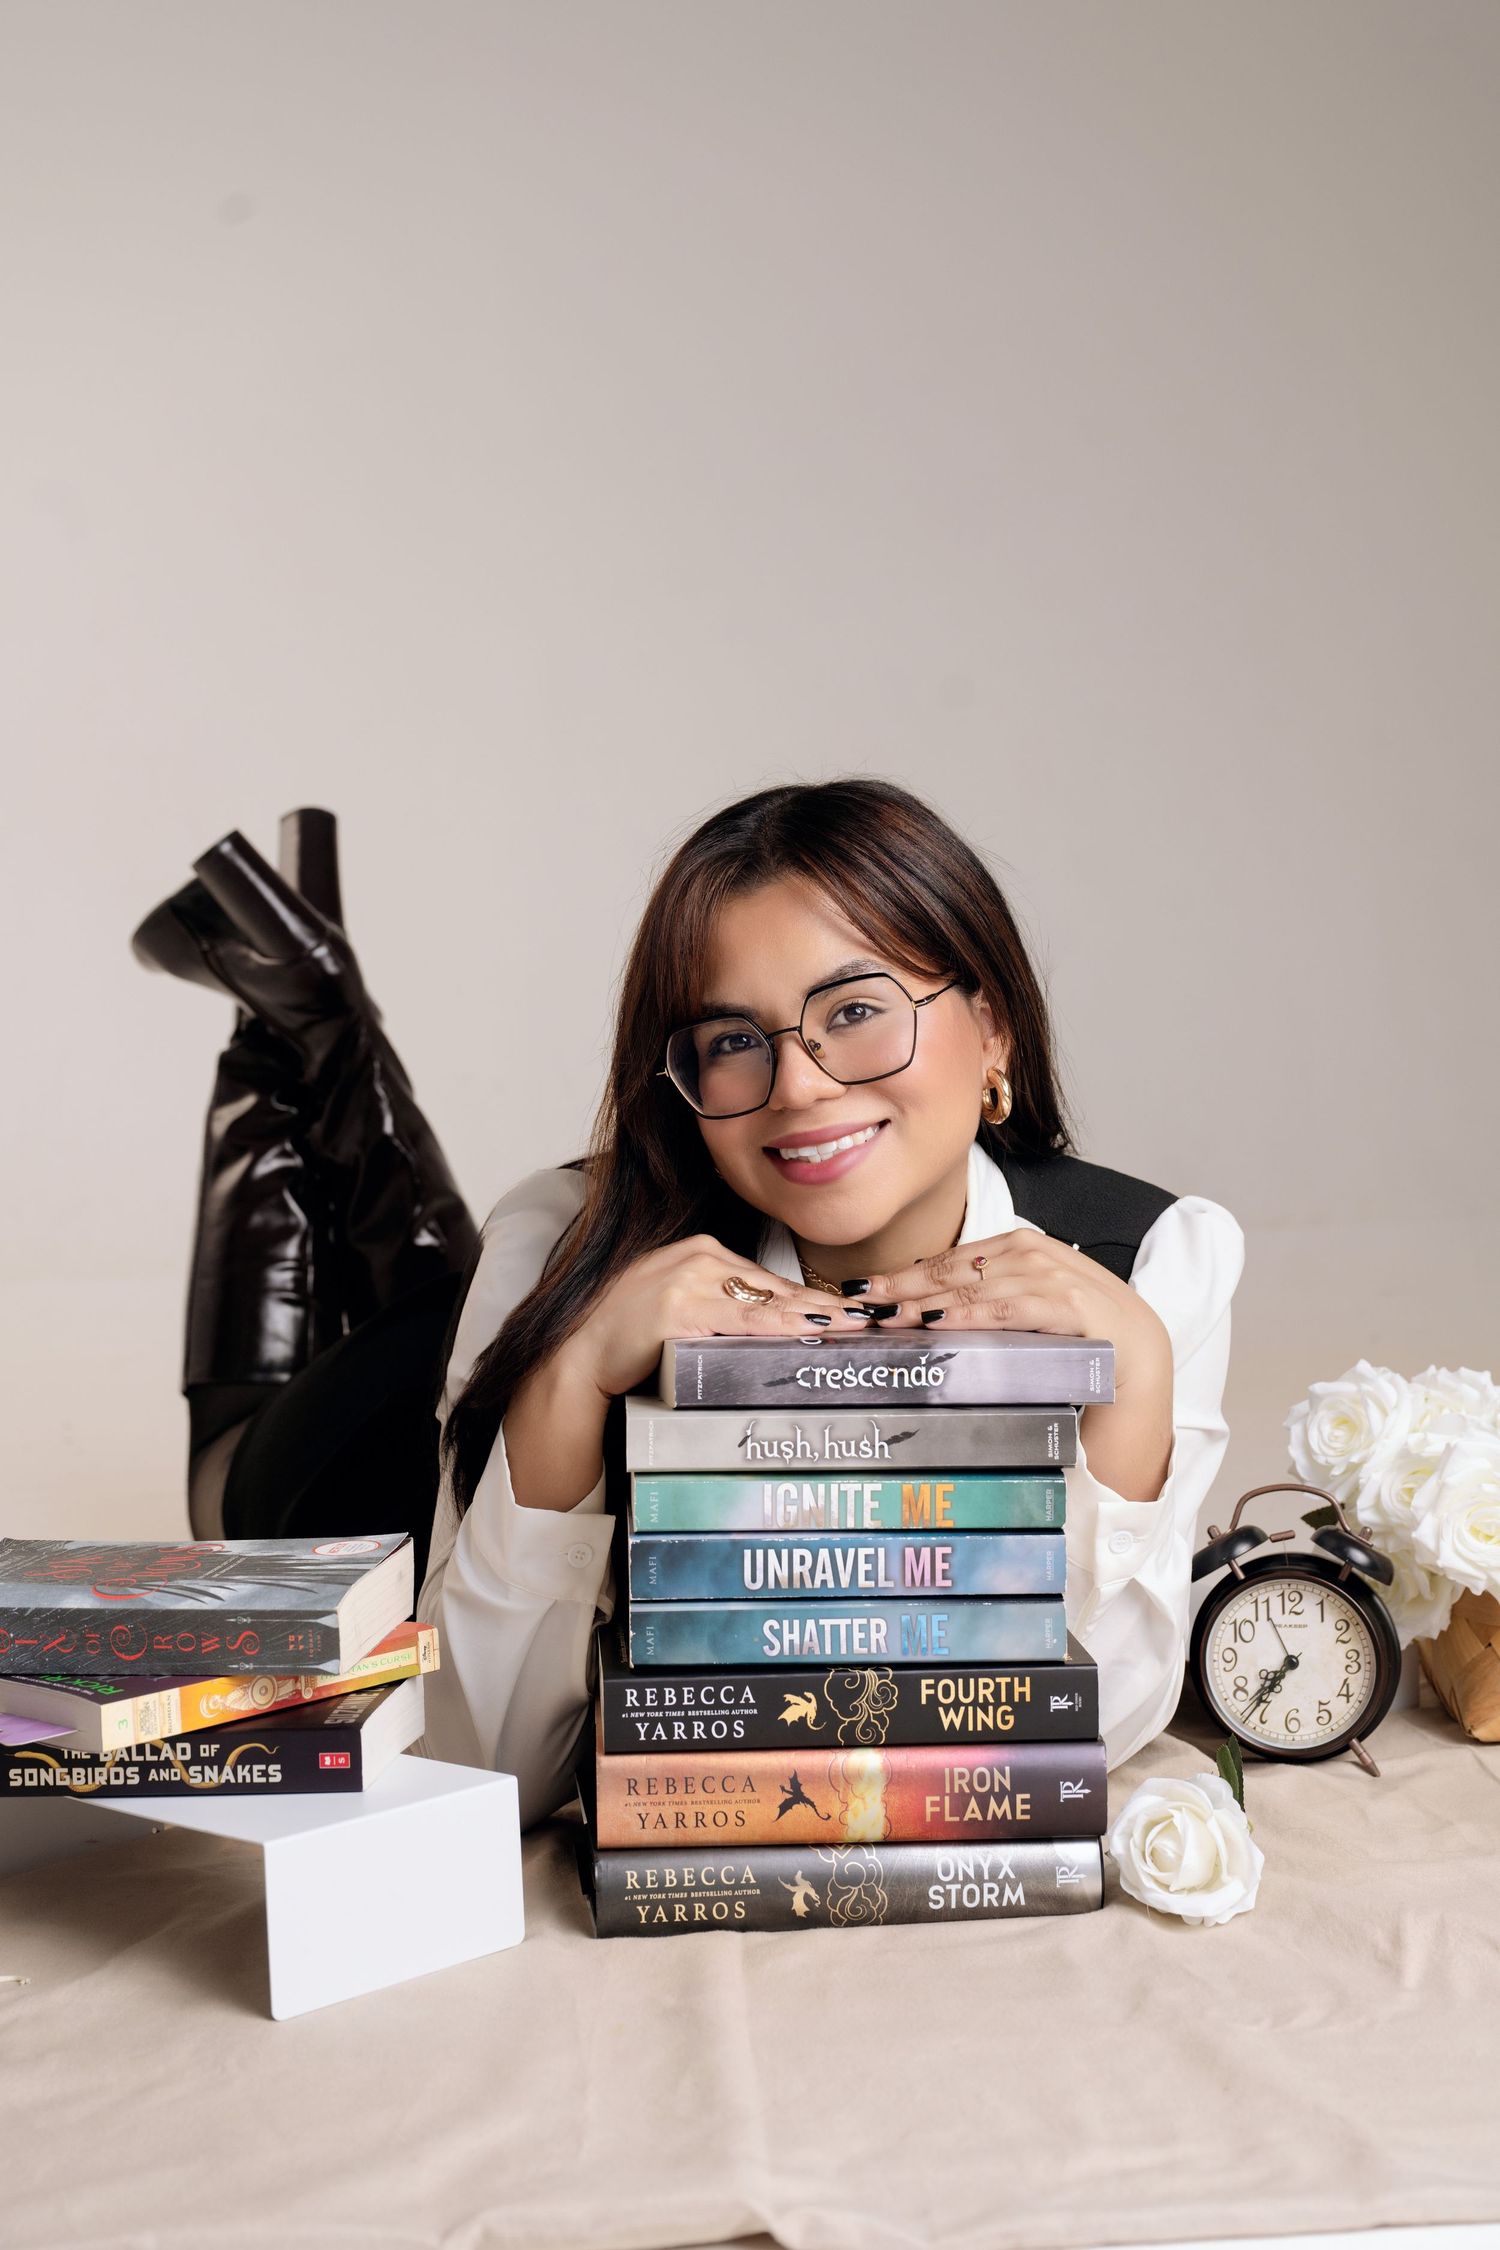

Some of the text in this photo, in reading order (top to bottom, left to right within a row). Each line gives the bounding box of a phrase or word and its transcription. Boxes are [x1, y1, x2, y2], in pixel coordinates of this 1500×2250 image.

[795, 1353, 947, 1390] crescendo
[745, 1419, 892, 1465] hush, hush
[649, 1491, 659, 1524] MAFI
[762, 1482, 955, 1529] IGNITE ME
[1045, 1488, 1053, 1522] HARPER
[648, 1555, 657, 1586] MAFI
[743, 1546, 953, 1591] UNRAVEL ME
[1045, 1550, 1053, 1582] HARPER
[1251, 1597, 1272, 1623] 11
[1277, 1590, 1305, 1616] 12
[1315, 1599, 1325, 1623] 1
[110, 1623, 261, 1662] CROWS
[646, 1626, 655, 1656] MAFI
[762, 1614, 949, 1657] SHATTER ME
[1044, 1617, 1052, 1649] HARPER
[1229, 1618, 1256, 1644] 10
[1334, 1618, 1352, 1645] 2
[379, 1652, 413, 1668] CURSE
[1222, 1647, 1238, 1673] 9
[1344, 1648, 1362, 1675] 3
[625, 1685, 756, 1707] REBECCA
[920, 1676, 1031, 1705] FOURTH
[1232, 1675, 1249, 1702] 8
[1336, 1677, 1354, 1704] 4
[687, 1709, 730, 1717] BESTSELLING
[938, 1705, 1015, 1732] WING
[1258, 1699, 1273, 1725] 7
[1284, 1708, 1301, 1734] 6
[1316, 1699, 1332, 1726] 5
[635, 1720, 745, 1741] YARROS
[100, 1743, 192, 1762] BALLAD
[200, 1744, 220, 1757] OF
[9, 1764, 282, 1787] SONGBIRDS AND SNAKES
[626, 1775, 757, 1796] REBECCA
[944, 1766, 1011, 1793] IRON
[636, 1810, 746, 1830] YARROS
[925, 1793, 1032, 1822] FLAME
[625, 1865, 757, 1890] REBECCA
[936, 1855, 1016, 1882] ONYX
[690, 1890, 733, 1898] BESTSELLING
[734, 1888, 761, 1896] AUTHOR
[928, 1882, 1026, 1910] STORM
[636, 1901, 746, 1924] YARROS
